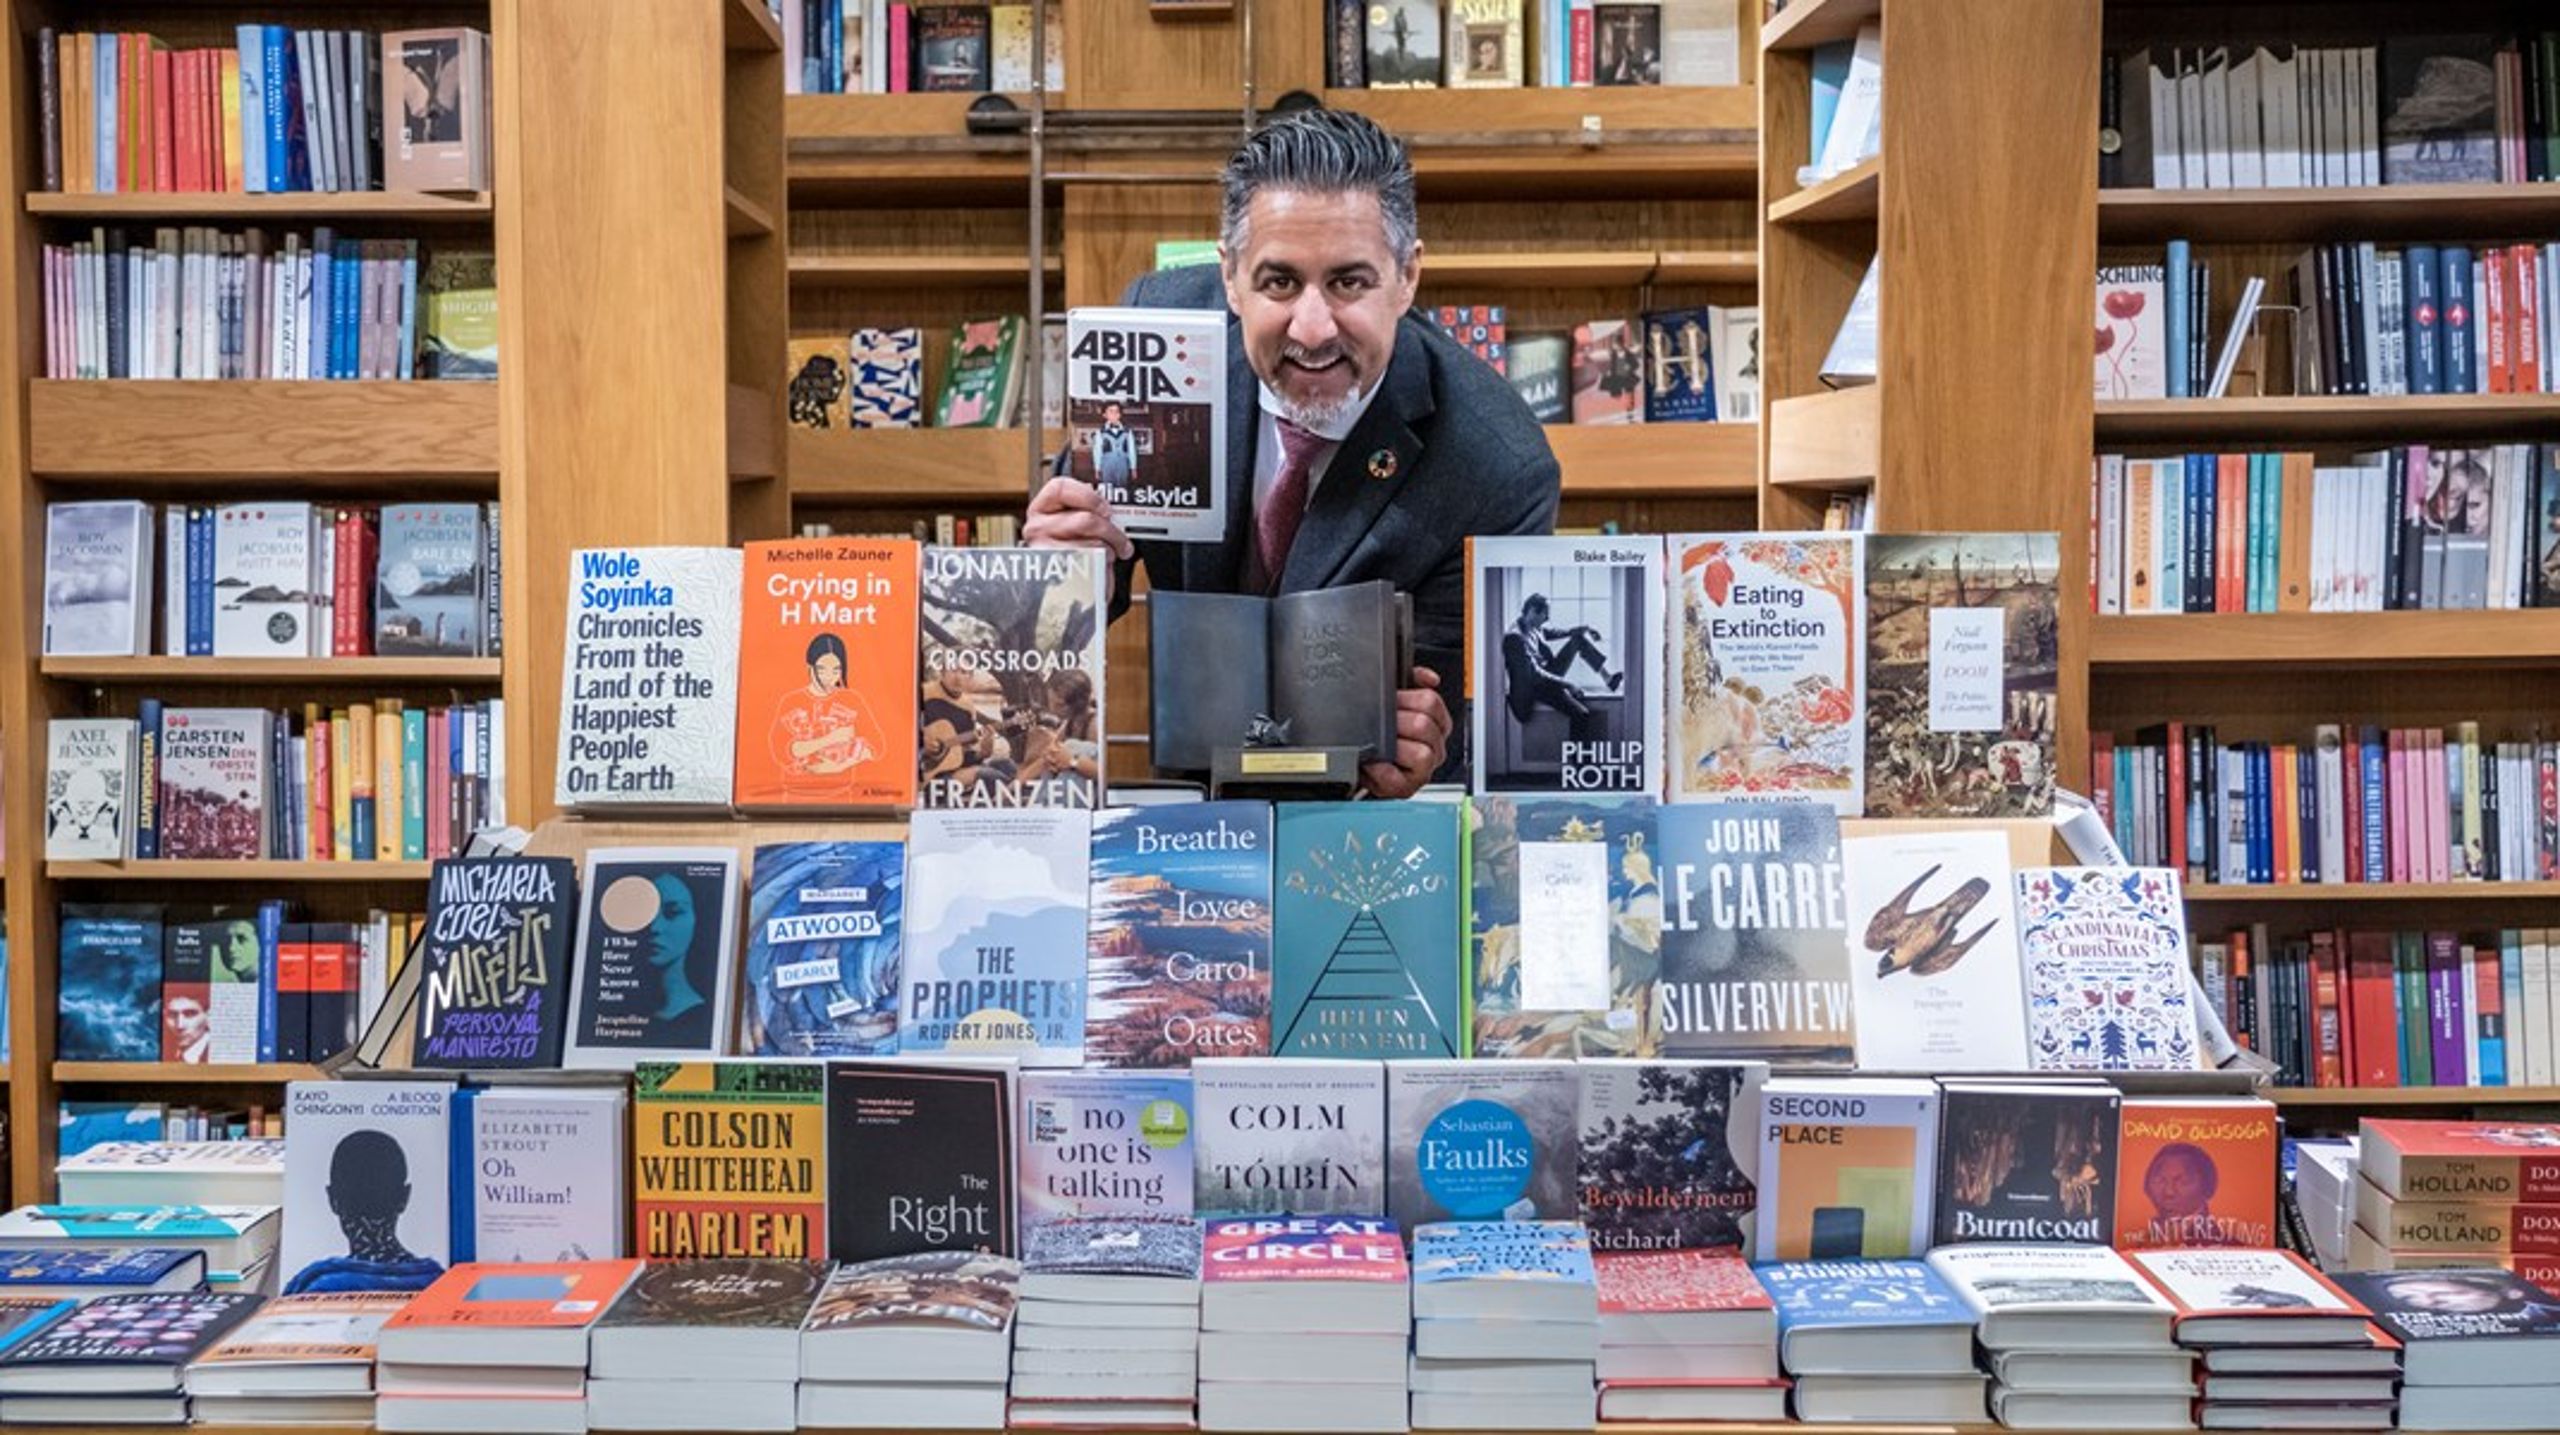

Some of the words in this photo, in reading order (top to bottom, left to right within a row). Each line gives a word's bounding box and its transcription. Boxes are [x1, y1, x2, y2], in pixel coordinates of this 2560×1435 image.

[1071, 330, 1168, 363] ABID
[1090, 364, 1181, 402] RAJA
[1134, 485, 1199, 510] skyld
[444, 513, 472, 525] ROY
[277, 528, 305, 539] ROY
[403, 529, 472, 542] JACOBSEN
[238, 542, 305, 555] JACOBSEN
[767, 549, 833, 563] Michelle
[837, 547, 894, 562] Zauner
[1574, 549, 1606, 564] Blake
[1609, 549, 1647, 567] Bailey
[582, 551, 640, 580] Wole
[928, 552, 1091, 583] JONATHAN
[580, 580, 674, 612] Soyinka
[767, 573, 857, 601] Crying
[866, 571, 891, 597] in
[1733, 585, 1804, 608] Eating
[781, 603, 801, 626] H
[810, 602, 878, 626] Mart
[1760, 606, 1778, 621] to
[577, 611, 703, 641] Chronicles
[1712, 619, 1827, 639] Extinction
[575, 642, 636, 671] From
[643, 643, 684, 669] the
[1719, 642, 1736, 652] The
[931, 647, 1092, 675] CROSSROADS
[1732, 653, 1747, 663] and
[1748, 653, 1767, 664] Why
[1782, 653, 1805, 663] Need
[1943, 666, 1989, 679] DOOM
[573, 673, 632, 701] Land
[638, 671, 667, 700] of
[673, 672, 715, 700] the
[571, 701, 677, 736] Happiest
[67, 729, 109, 743] AXEL
[165, 730, 245, 744] CARSTEN
[58, 745, 117, 759] JENSEN
[165, 746, 231, 760] JENSEN
[231, 748, 257, 759] DEN
[568, 733, 650, 767] People
[1561, 741, 1643, 765] PHILIP
[209, 761, 257, 771] FØRSTE
[224, 771, 257, 782] STEN
[567, 765, 599, 794] On
[606, 764, 675, 792] Earth
[1561, 765, 1643, 789] ROTH
[929, 777, 1095, 810] FRANZEN
[1136, 820, 1257, 854] Breathe
[1705, 818, 1782, 854] JOHN
[1657, 863, 1699, 932] LE
[1709, 846, 1846, 931] CARRÉ
[1175, 891, 1257, 926] Joyce
[774, 915, 874, 939] ATWOOD
[2041, 918, 2164, 948] SCANDINAVIAN
[611, 937, 638, 948] Who
[2054, 938, 2152, 959] CHRISTMAS
[602, 951, 630, 962] Have
[976, 946, 1015, 975] THE
[1166, 949, 1257, 983] Carol
[601, 963, 634, 975] Never
[784, 964, 836, 982] DEARLY
[600, 978, 640, 988] Known
[526, 990, 541, 1012] A
[598, 991, 624, 1001] Men
[911, 979, 1078, 1021] PROPHETS
[1661, 979, 1849, 1033] SILVERVIEW
[595, 1014, 649, 1027] Jacqueline
[1319, 1008, 1410, 1027] HELEN
[595, 1027, 643, 1038] Harpman
[918, 1022, 982, 1041] ROBERT
[986, 1022, 1041, 1043] JONES,
[1164, 1015, 1258, 1047] Oates
[294, 1090, 330, 1102] KAYO
[387, 1091, 398, 1103] A
[400, 1091, 442, 1103] BLOOD
[293, 1102, 365, 1115] CHINGONYI
[371, 1103, 442, 1116] CONDITION
[1083, 1107, 1127, 1130] no
[1228, 1103, 1346, 1131] COLM
[1768, 1097, 1866, 1119] SECOND
[480, 1122, 579, 1136] ELIZABETH
[661, 1111, 794, 1150] COLSON
[1439, 1115, 1514, 1133] Sebastian
[2123, 1120, 2184, 1141] DAVID
[2187, 1121, 2270, 1141] OLUSOGA
[480, 1139, 549, 1151] STROUT
[1768, 1125, 1845, 1145] PLACE
[1056, 1140, 1119, 1165] one
[1127, 1137, 1153, 1165] is
[1423, 1138, 1529, 1172] Faulks
[482, 1157, 517, 1179] Oh
[640, 1156, 814, 1194] WHITEHEAD
[1214, 1157, 1359, 1191] TÓIBÍN
[2446, 1162, 2475, 1173] TOM
[961, 1173, 990, 1190] The
[1047, 1168, 1165, 1207] talking
[2409, 1176, 2512, 1193] HOLLAND
[483, 1184, 573, 1205] William!
[1585, 1183, 1755, 1208] Bewilderment
[888, 1194, 991, 1246] Right
[1218, 1218, 1385, 1237] GREAT
[1955, 1209, 2101, 1241] Burntcoat
[2436, 1212, 2467, 1222] TOM
[648, 1210, 809, 1260] HARLEM
[1458, 1223, 1544, 1234] SALLY
[1587, 1228, 1682, 1249] Richard
[2123, 1231, 2146, 1244] THE
[2147, 1214, 2267, 1246] INTERESTING
[2399, 1225, 2502, 1243] HOLLAND
[1211, 1243, 1397, 1264] CIRCLE
[15, 1346, 157, 1359] KITAMURA
[27, 1338, 110, 1350] KATIE
